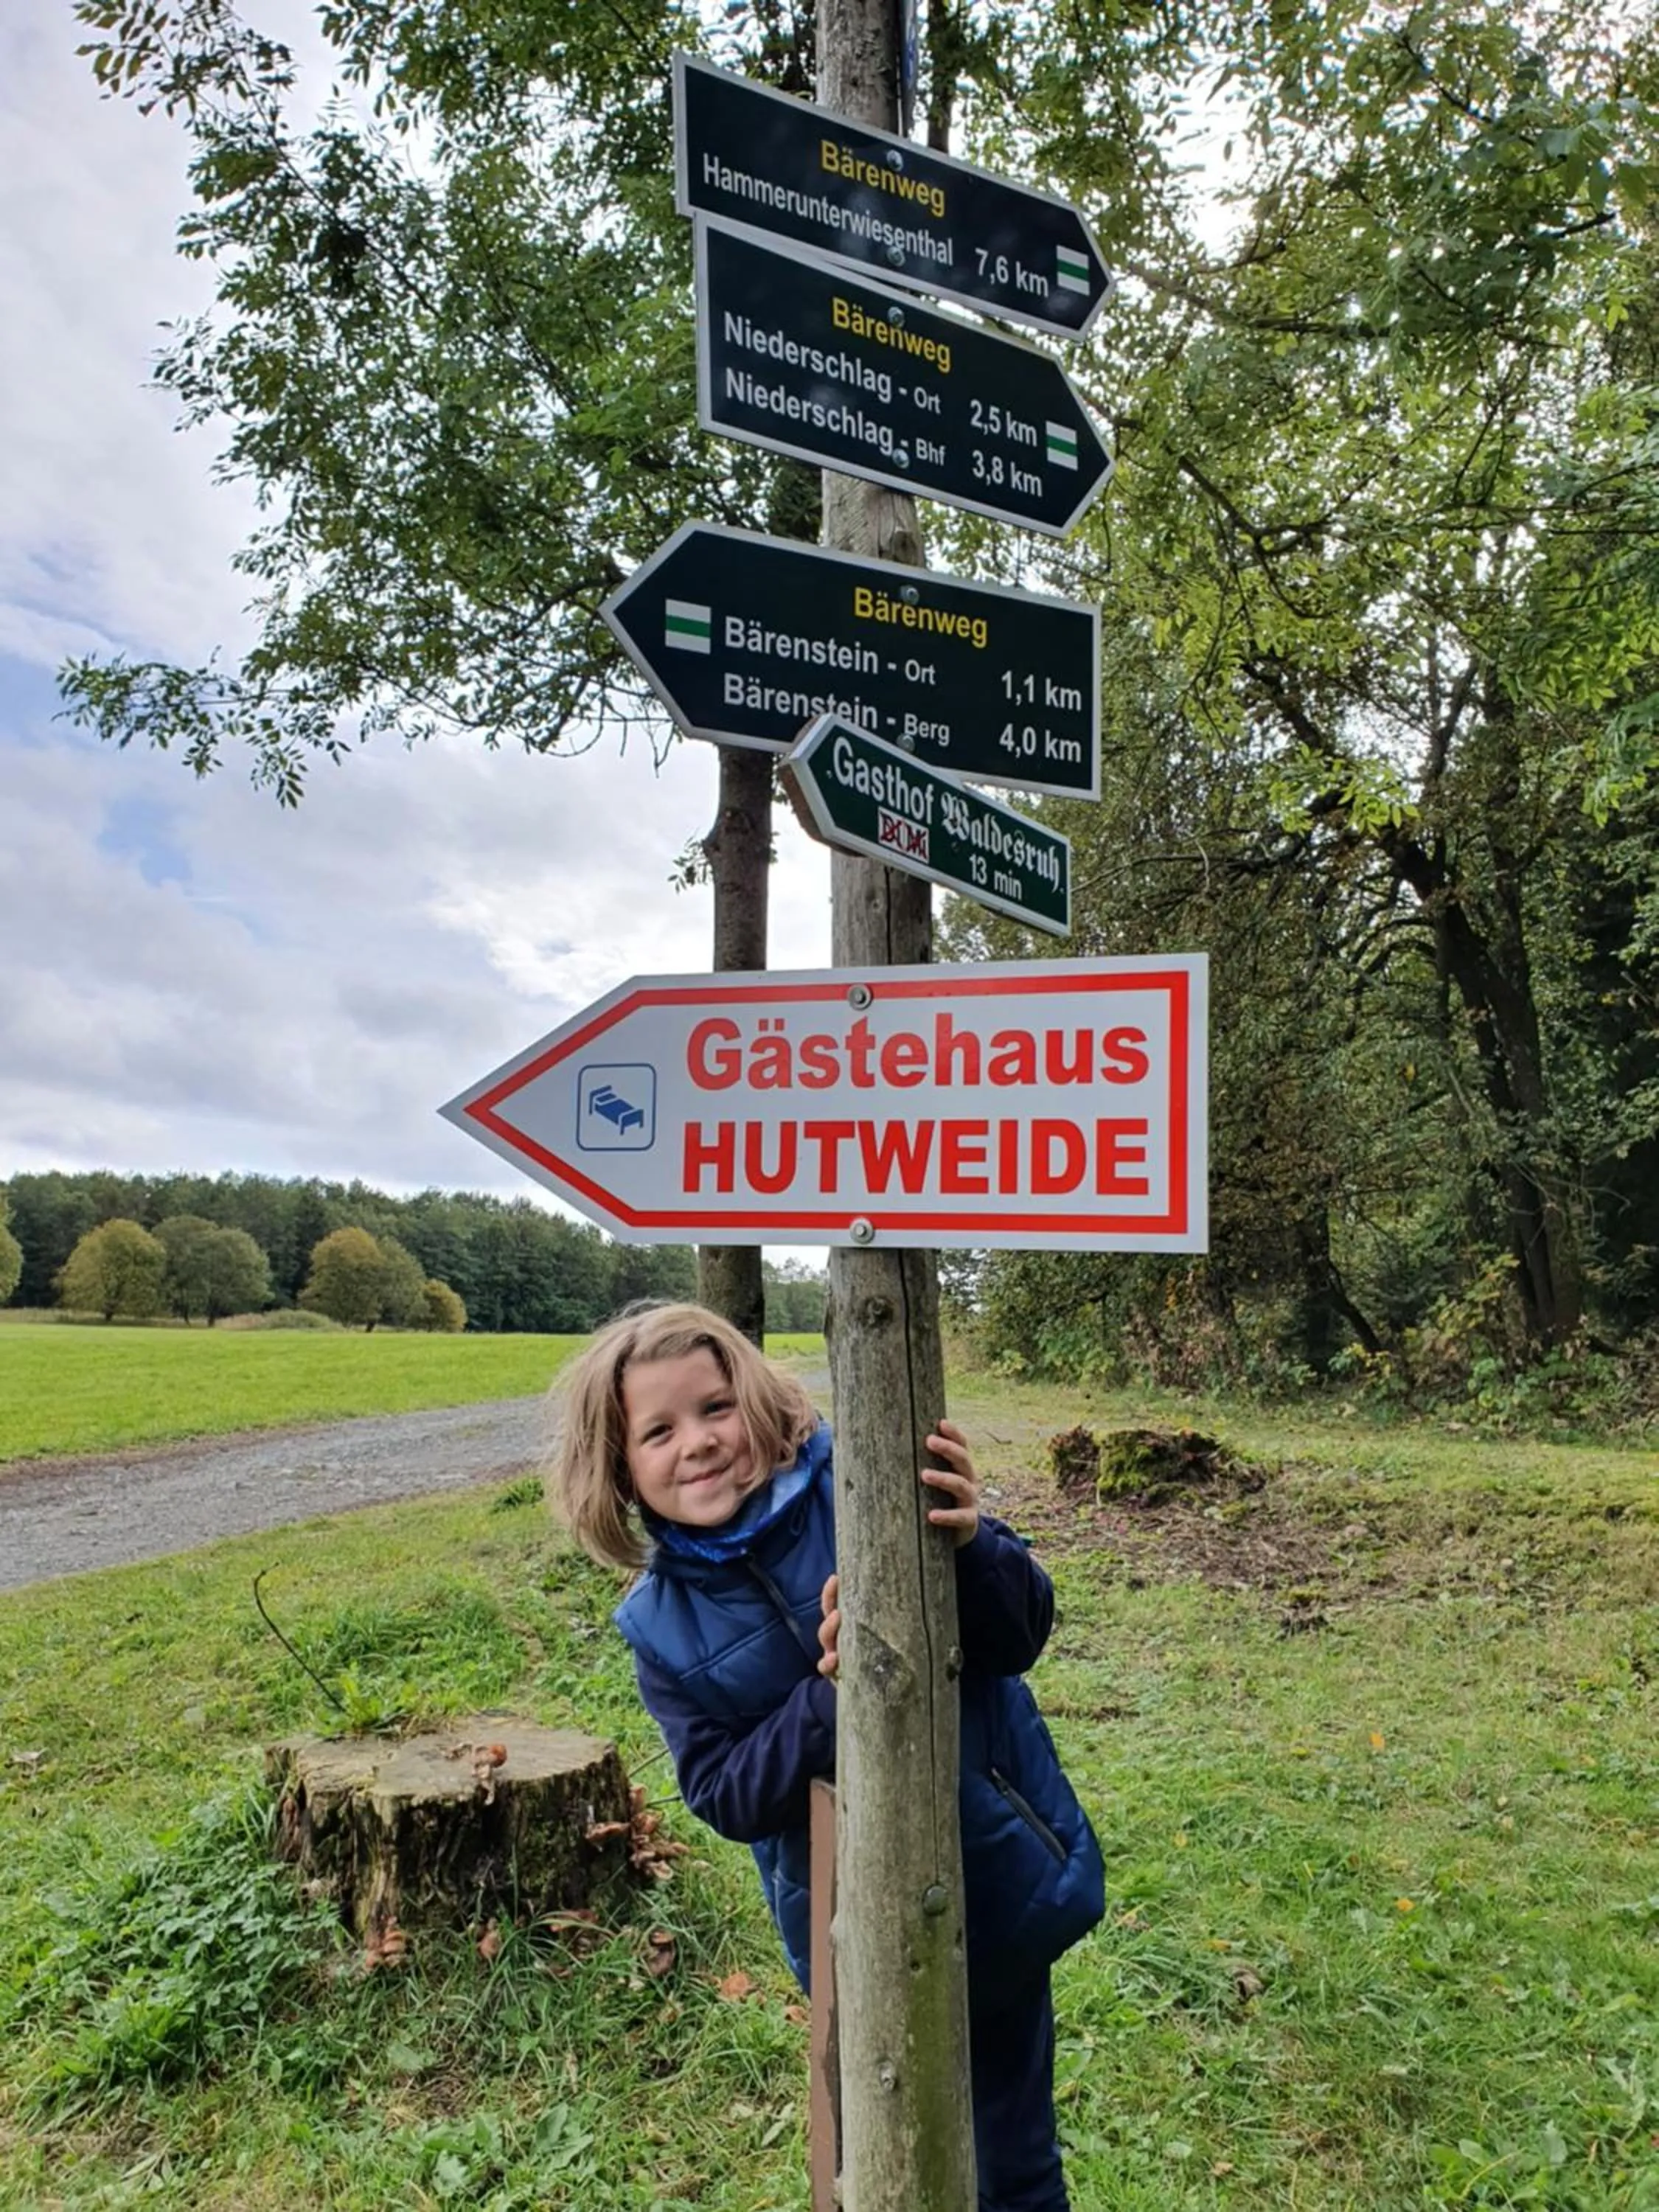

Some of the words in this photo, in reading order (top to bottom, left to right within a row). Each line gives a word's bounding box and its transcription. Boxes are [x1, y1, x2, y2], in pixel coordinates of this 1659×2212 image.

[821, 140, 945, 217] Bärenweg
[703, 153, 953, 266] Hammerunterwiesenthal
[975, 248, 1009, 286] 7,6
[1015, 260, 1048, 297] km
[832, 297, 951, 372] Bärenweg
[723, 311, 891, 403] Niederschlag
[914, 386, 941, 414] Ort
[970, 400, 1001, 434] 2,5
[1006, 411, 1037, 445] km
[726, 367, 893, 456] Niederschlag
[915, 437, 945, 467] Bhf
[972, 450, 1004, 485] 3,8
[1010, 460, 1043, 497] km
[854, 587, 988, 648] Bärenweg
[725, 616, 878, 674] Bärenstein
[905, 659, 936, 686] Ort
[1001, 670, 1034, 703] 1,1
[1045, 678, 1082, 711] km
[723, 673, 877, 730] Bärenstein
[904, 713, 950, 748] Berg
[999, 723, 1035, 759] 4,0
[1044, 729, 1082, 764] km
[832, 736, 933, 824] Gasthof
[941, 791, 1060, 893] Waldesruh
[969, 852, 988, 884] 13
[993, 869, 1023, 901] min
[687, 1012, 1150, 1091] Gästehaus
[683, 1118, 1150, 1195] HUTWEIDE
